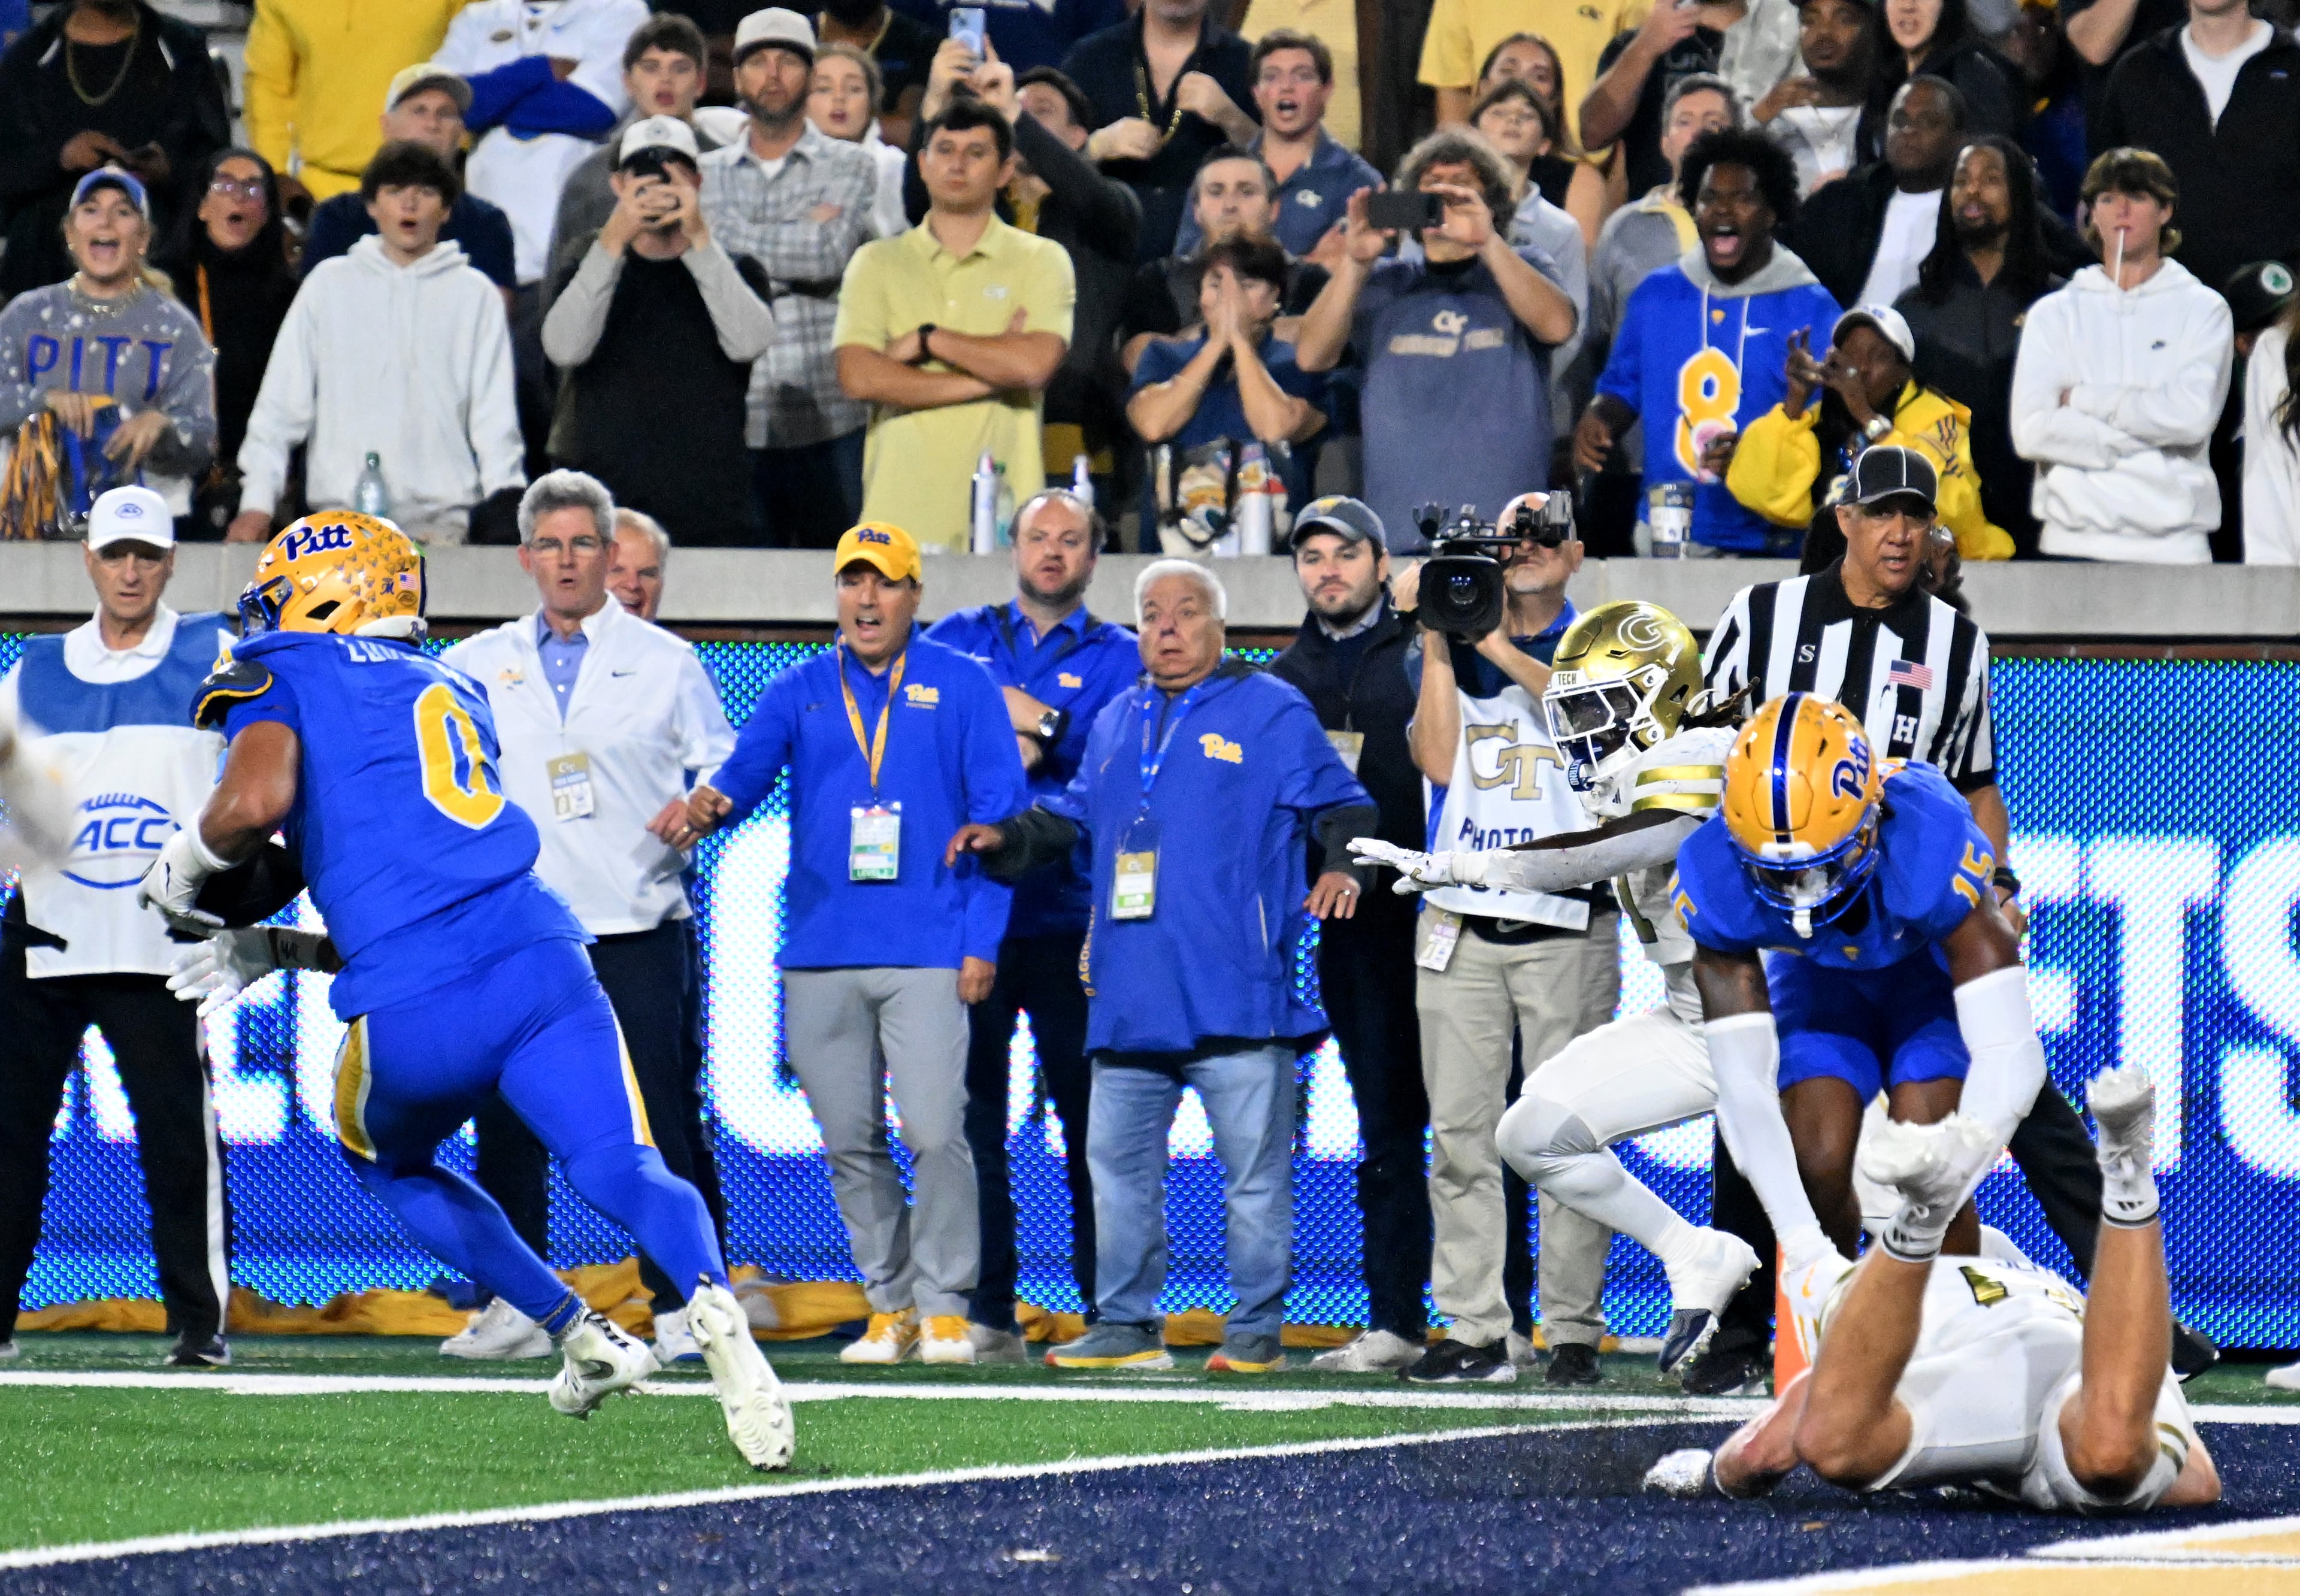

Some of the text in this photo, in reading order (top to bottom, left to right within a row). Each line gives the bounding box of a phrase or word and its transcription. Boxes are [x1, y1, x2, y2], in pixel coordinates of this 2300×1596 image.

[28, 334, 172, 401] PITT
[1675, 346, 1741, 478] 8
[277, 523, 355, 562] Pitt
[855, 528, 891, 546] Pitt
[1798, 644, 1815, 662] S
[904, 683, 939, 704] Pitt
[1558, 673, 1576, 686] TECH
[1199, 732, 1243, 764] Pitt
[1893, 714, 1918, 744] H
[413, 682, 506, 830] 0
[1465, 719, 1564, 800] GT
[1832, 734, 1869, 801] Pitt
[67, 817, 171, 855] ACC
[1459, 816, 1534, 852] PHOTO
[1953, 840, 1996, 909] 15
